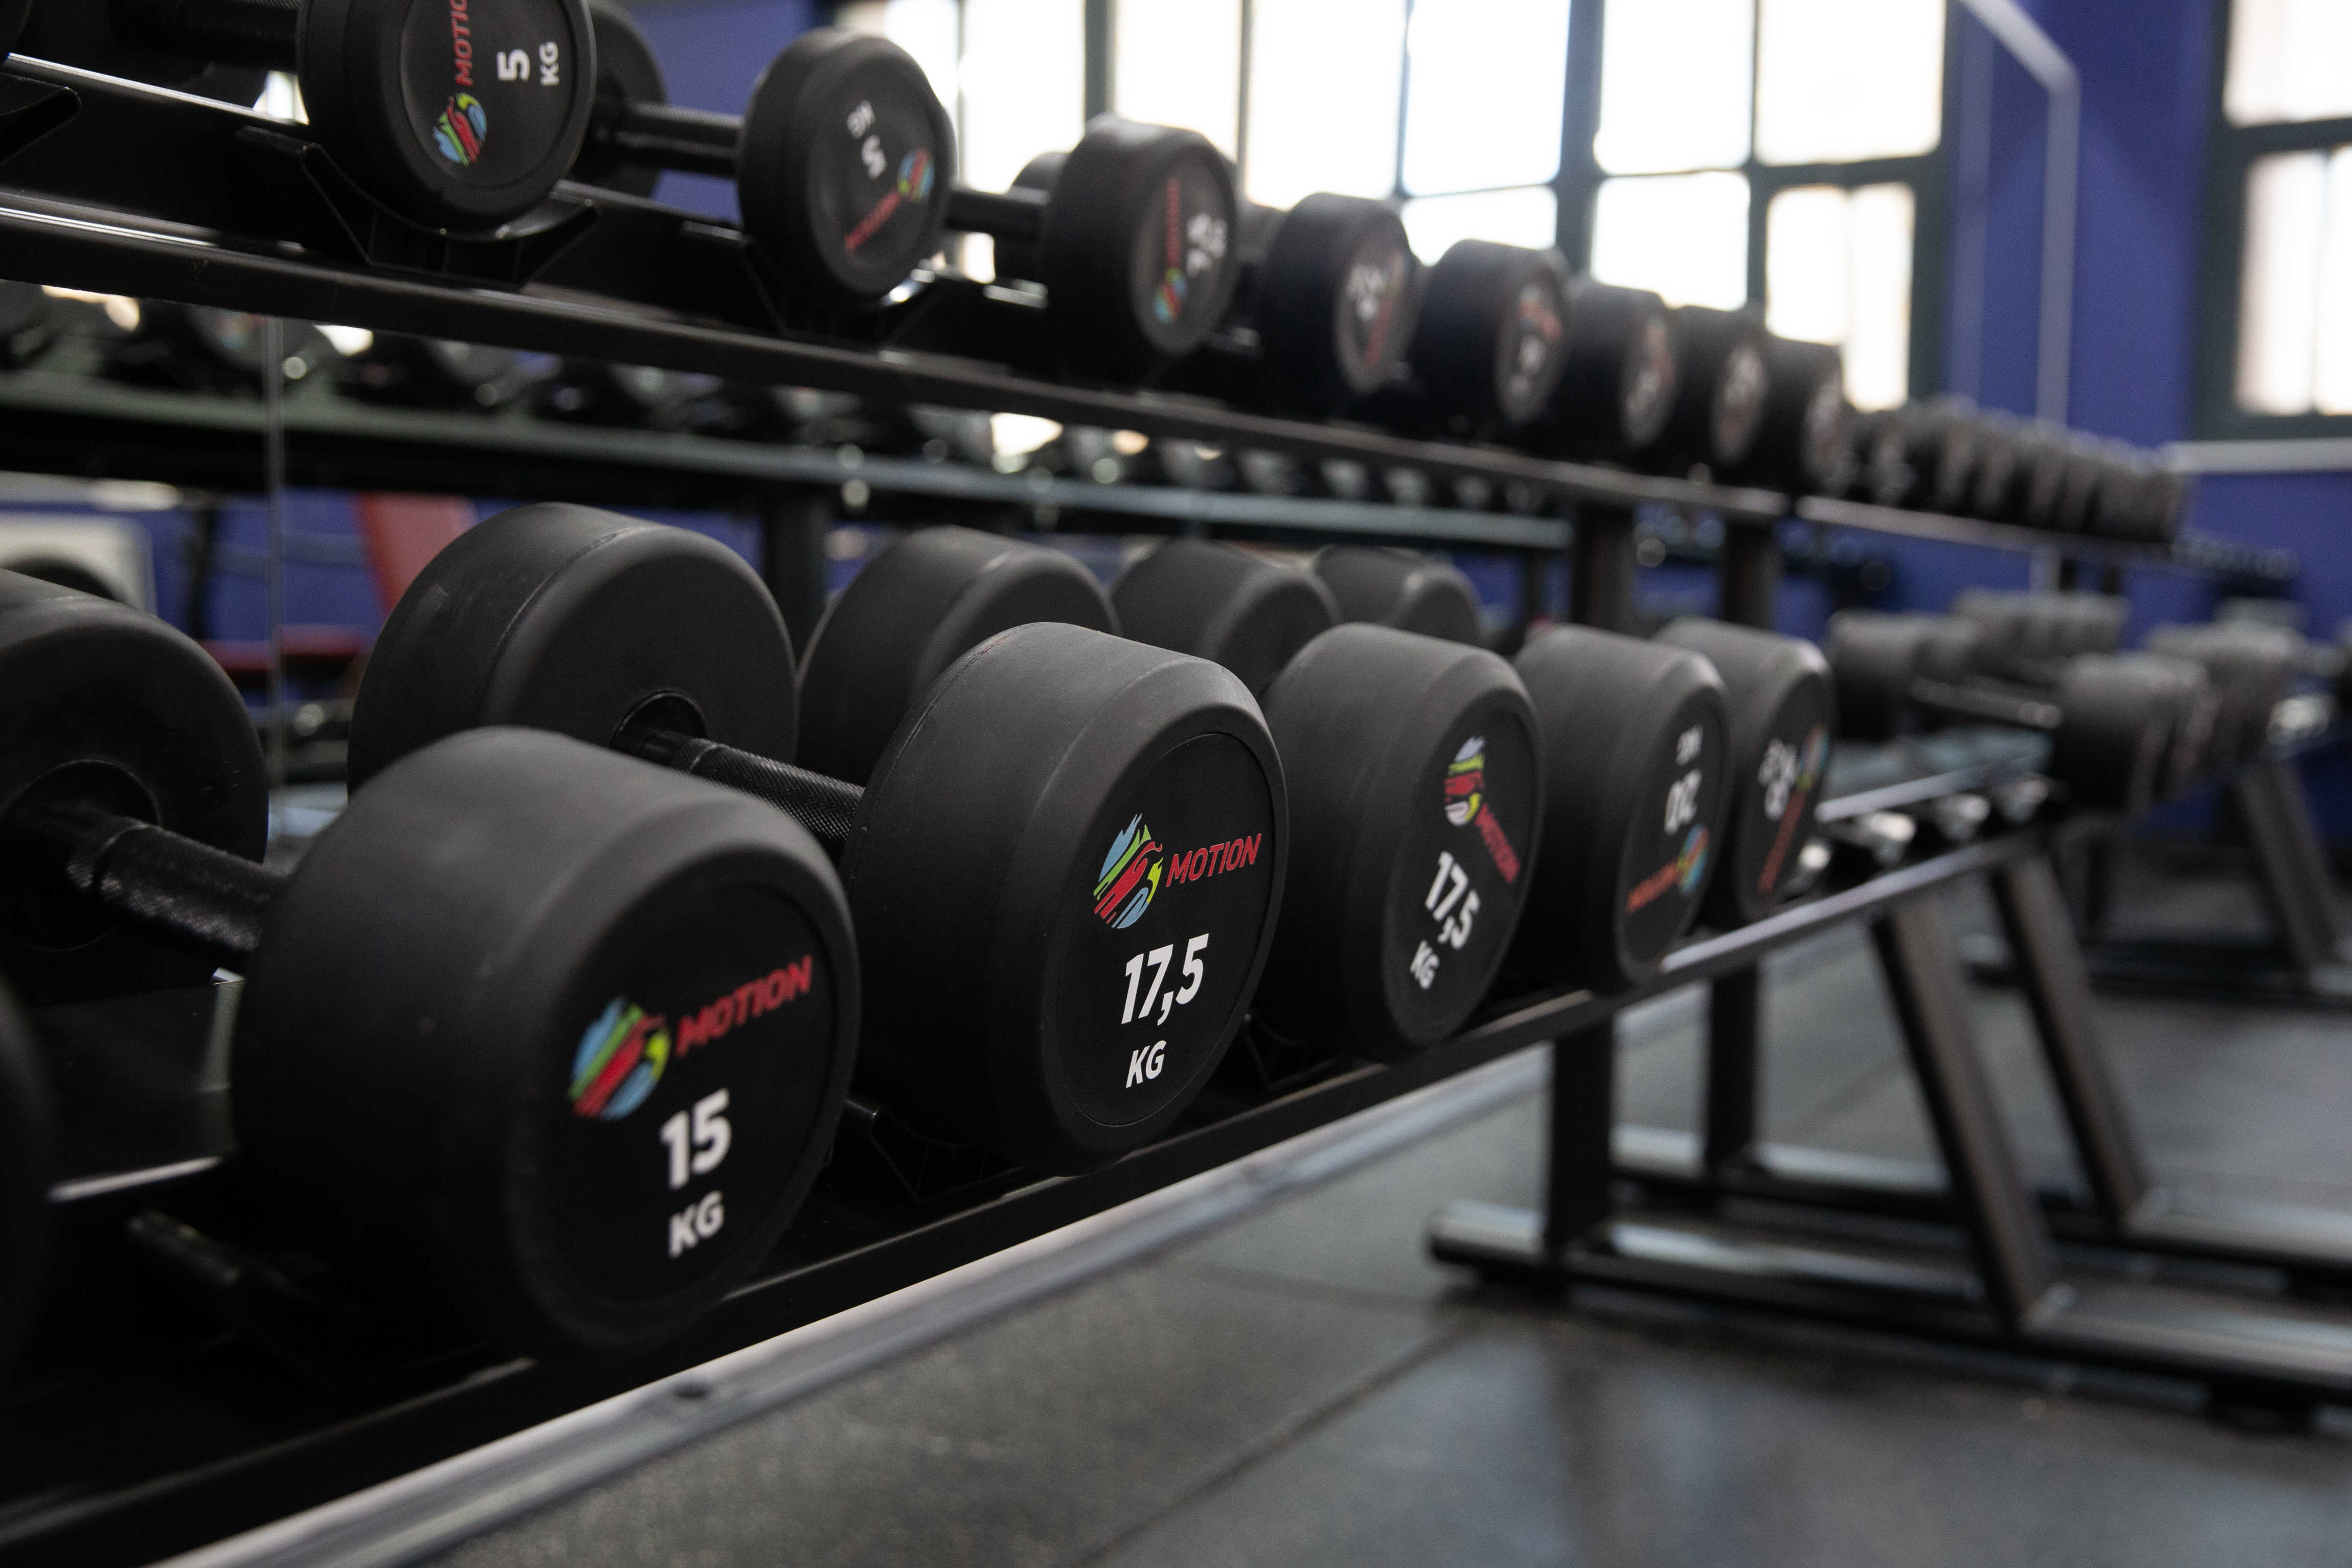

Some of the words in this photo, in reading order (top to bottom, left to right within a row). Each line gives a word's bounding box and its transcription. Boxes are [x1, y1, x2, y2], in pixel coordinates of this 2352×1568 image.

[497, 49, 530, 81] 5
[539, 41, 559, 85] KG
[1166, 833, 1261, 887] MOTION
[1425, 850, 1480, 949] 17,5
[676, 955, 812, 1054] MOTION
[1122, 933, 1209, 1026] 17,5
[1126, 1040, 1167, 1088] KG
[661, 1088, 731, 1189] 15
[669, 1191, 724, 1257] KG
